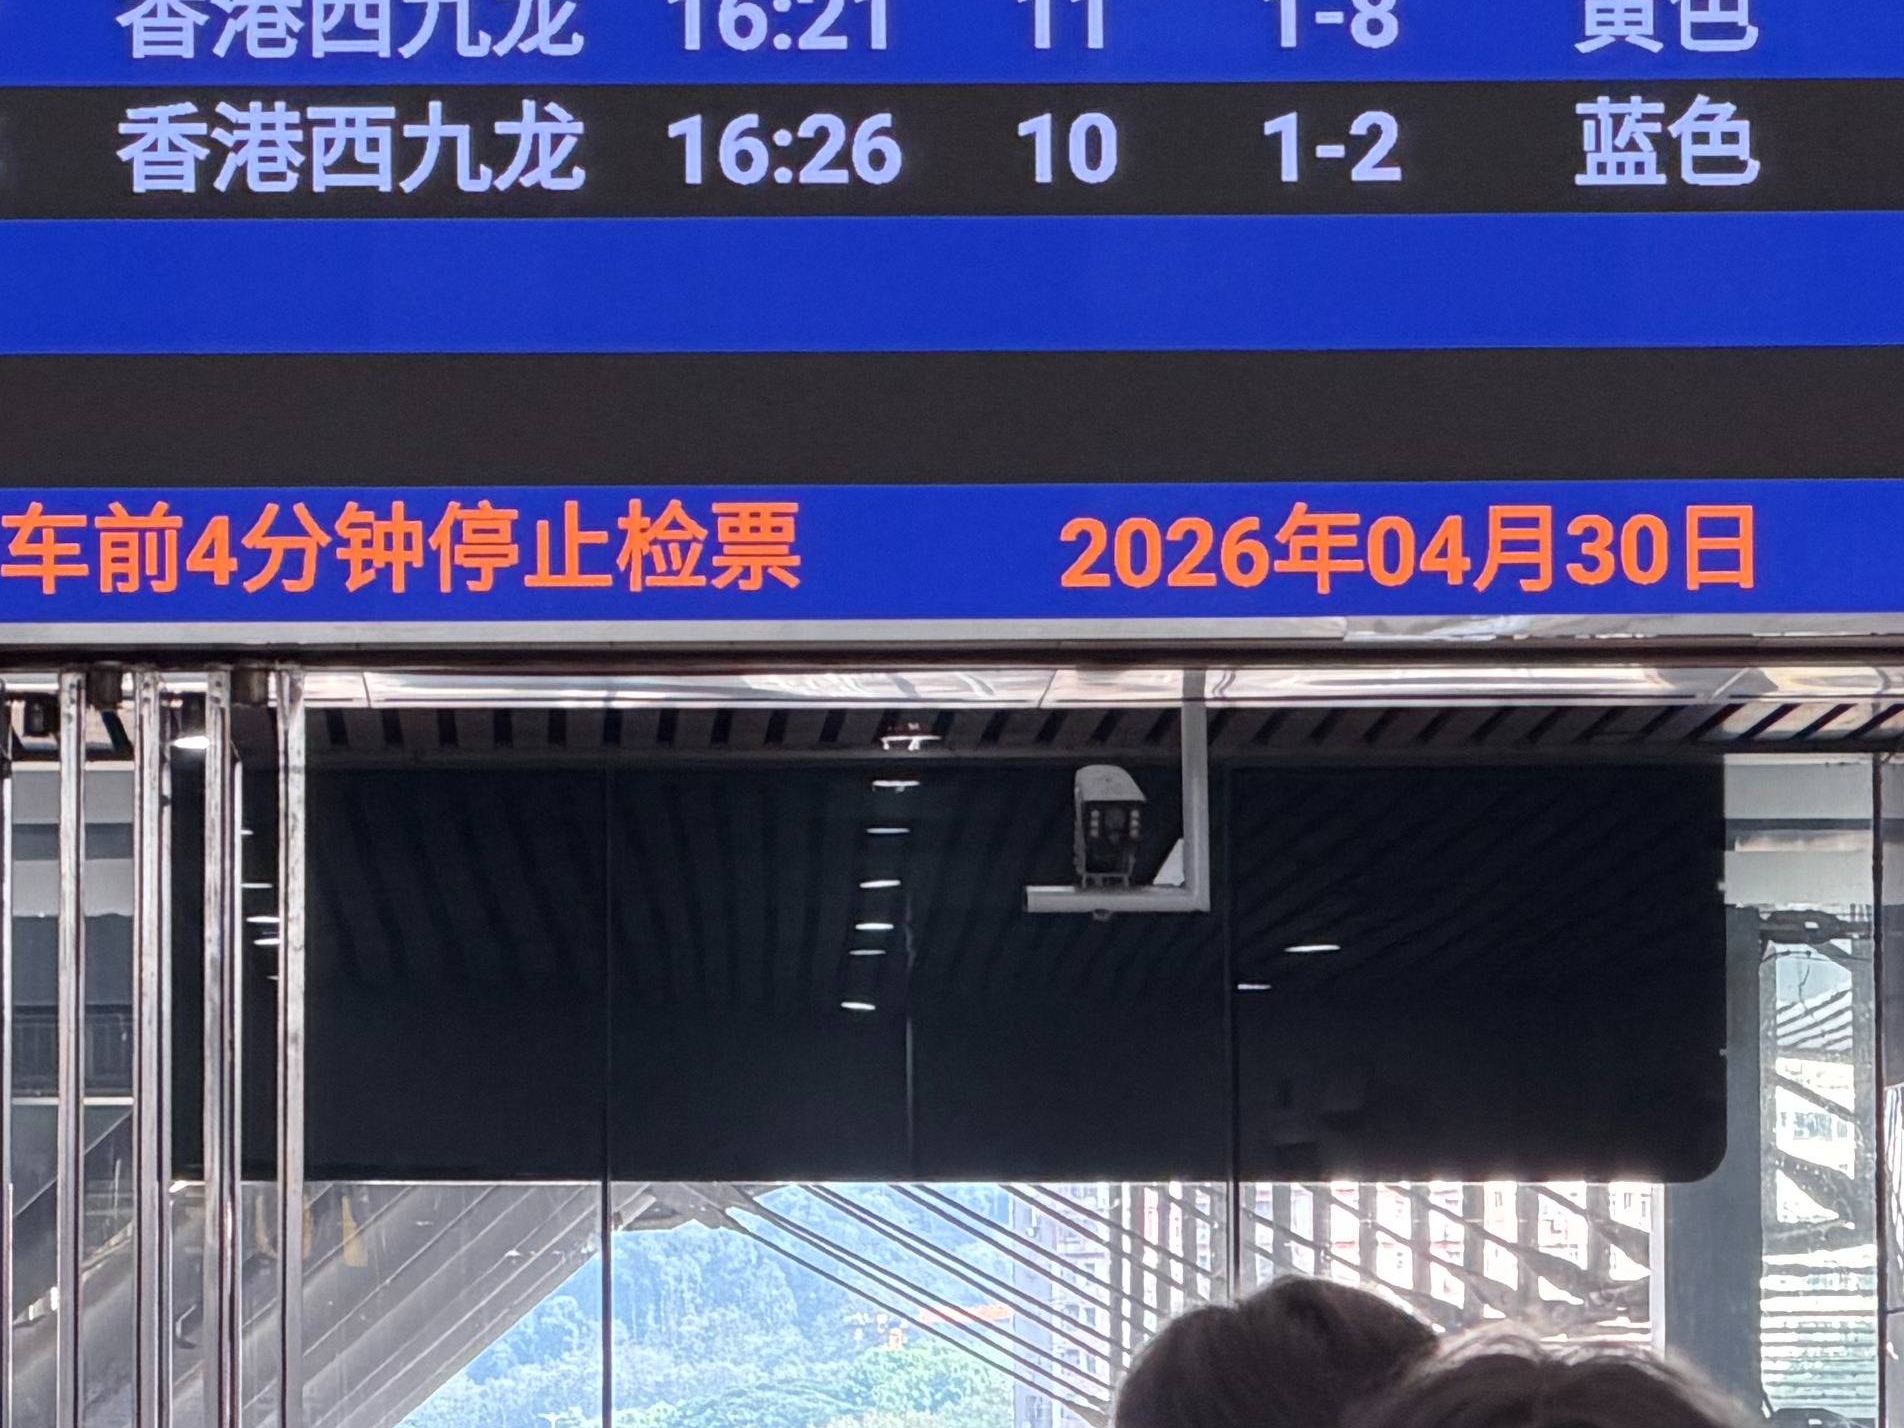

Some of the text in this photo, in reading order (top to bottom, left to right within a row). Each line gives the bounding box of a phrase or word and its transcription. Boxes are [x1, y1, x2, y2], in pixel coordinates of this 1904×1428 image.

[116, 99, 586, 193] 香港西九龙
[668, 113, 903, 185] 16:26
[1018, 112, 1118, 184] 10
[1264, 111, 1402, 182] 1-2
[1575, 94, 1760, 186] 蓝色
[1060, 502, 1755, 595] 2026年04月30日
